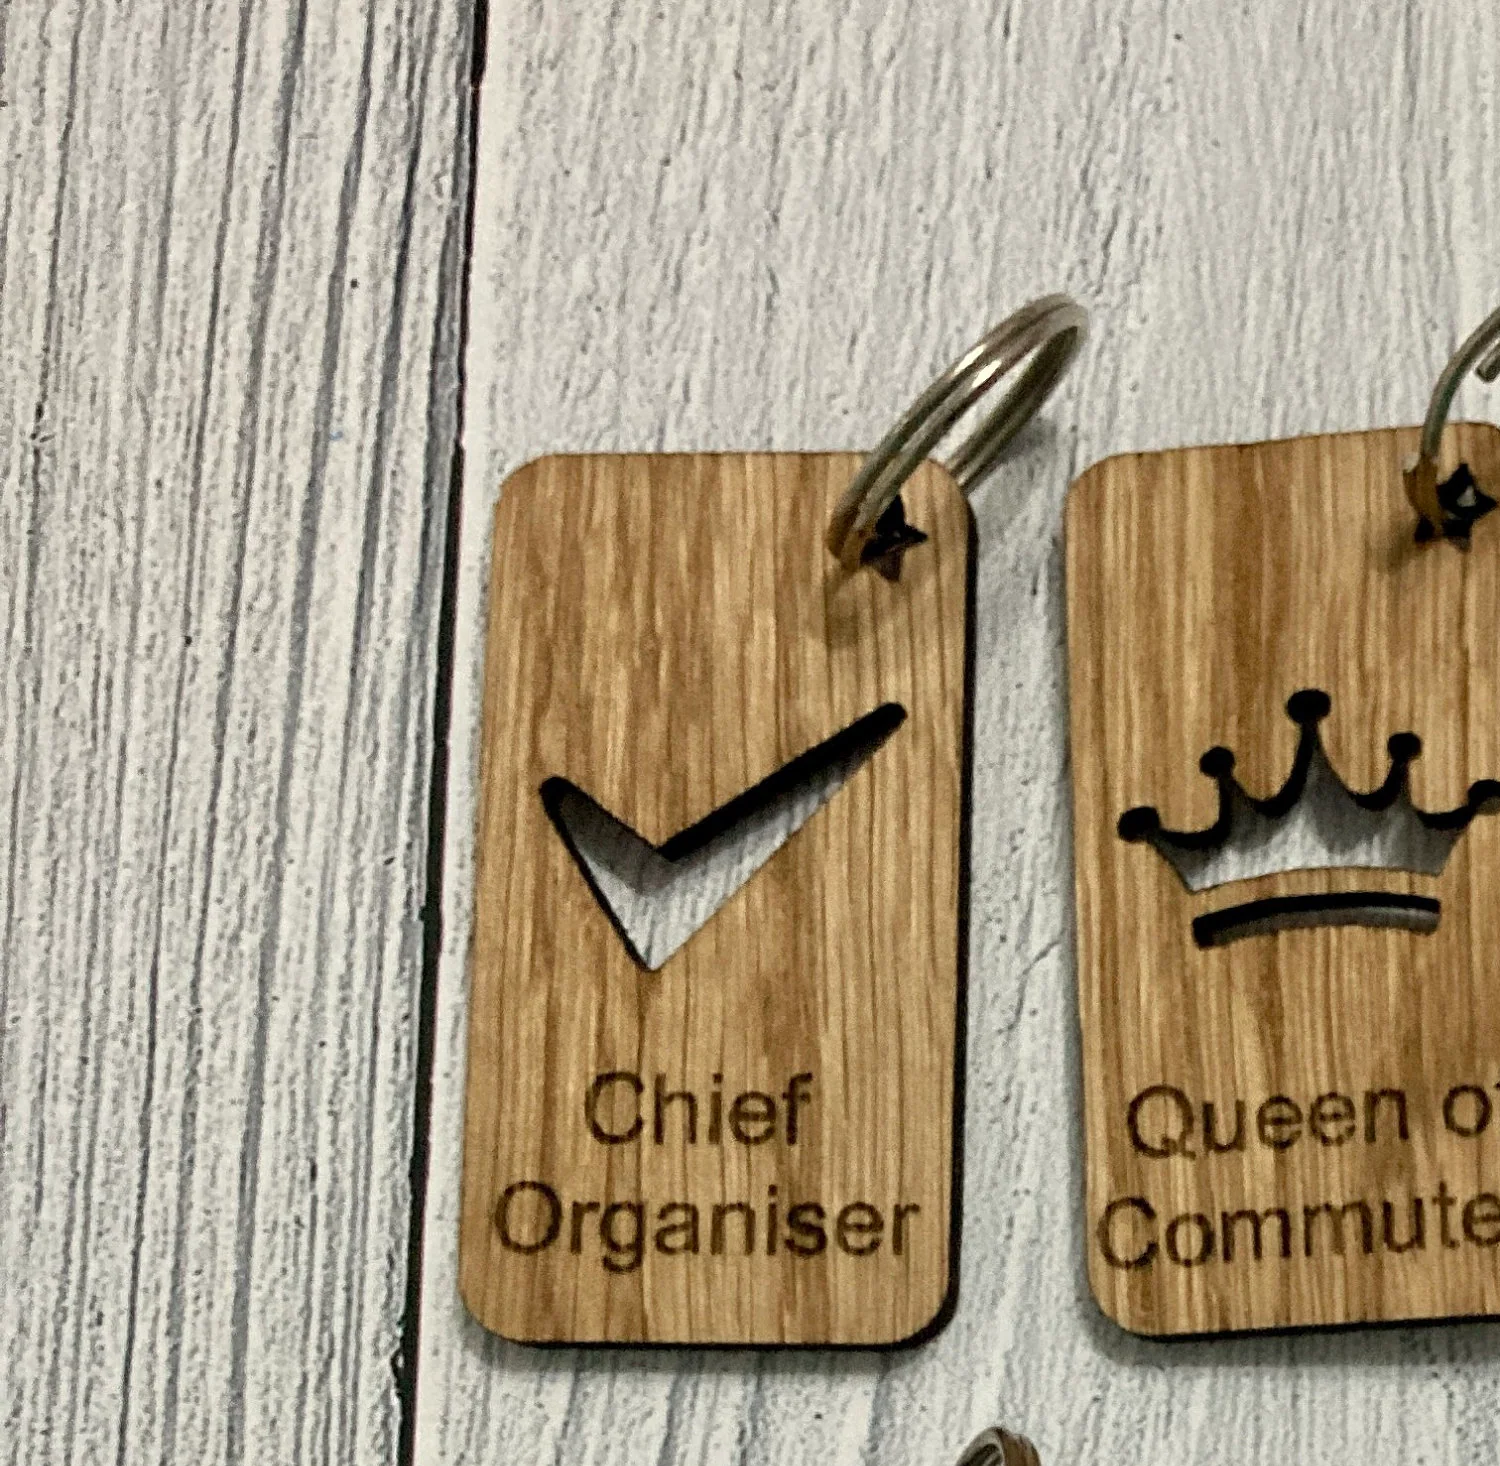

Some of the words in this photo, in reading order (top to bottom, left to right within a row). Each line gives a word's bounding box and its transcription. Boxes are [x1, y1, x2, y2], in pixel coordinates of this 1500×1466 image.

[585, 1070, 813, 1146] Chief
[1126, 1083, 1410, 1160] Queen
[496, 1180, 921, 1273] Organiser
